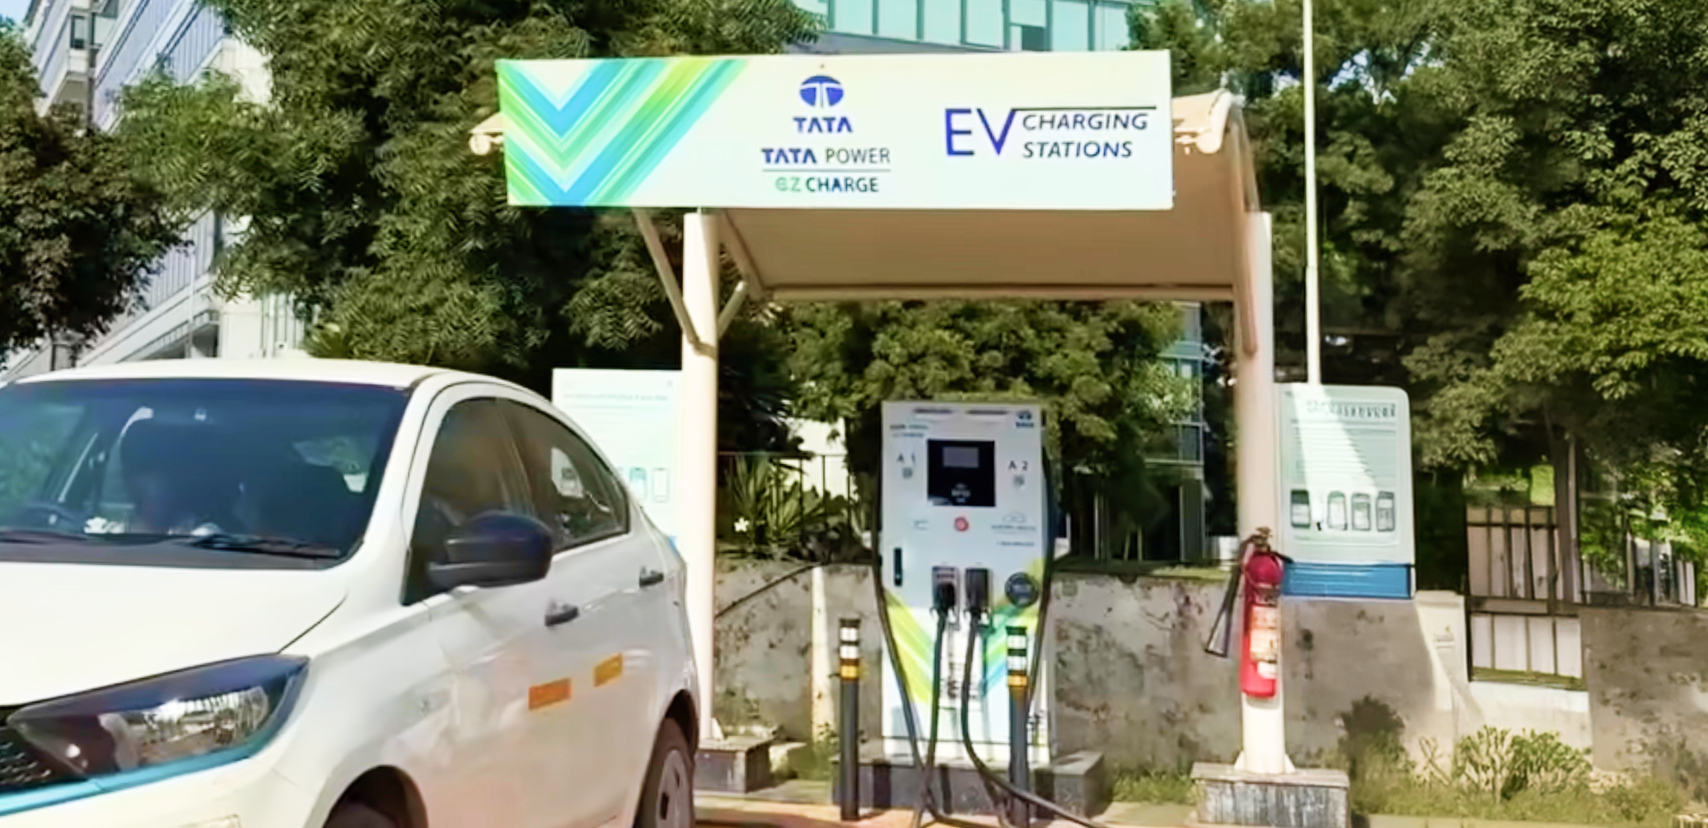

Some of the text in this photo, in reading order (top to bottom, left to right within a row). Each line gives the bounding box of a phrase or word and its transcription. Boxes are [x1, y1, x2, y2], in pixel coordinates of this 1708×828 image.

[793, 116, 852, 133] TATA
[945, 108, 1149, 156] EV CHARGING
[761, 147, 890, 164] TATA POWER
[1022, 141, 1133, 158] STATIONS
[805, 176, 879, 192] CHARGE
